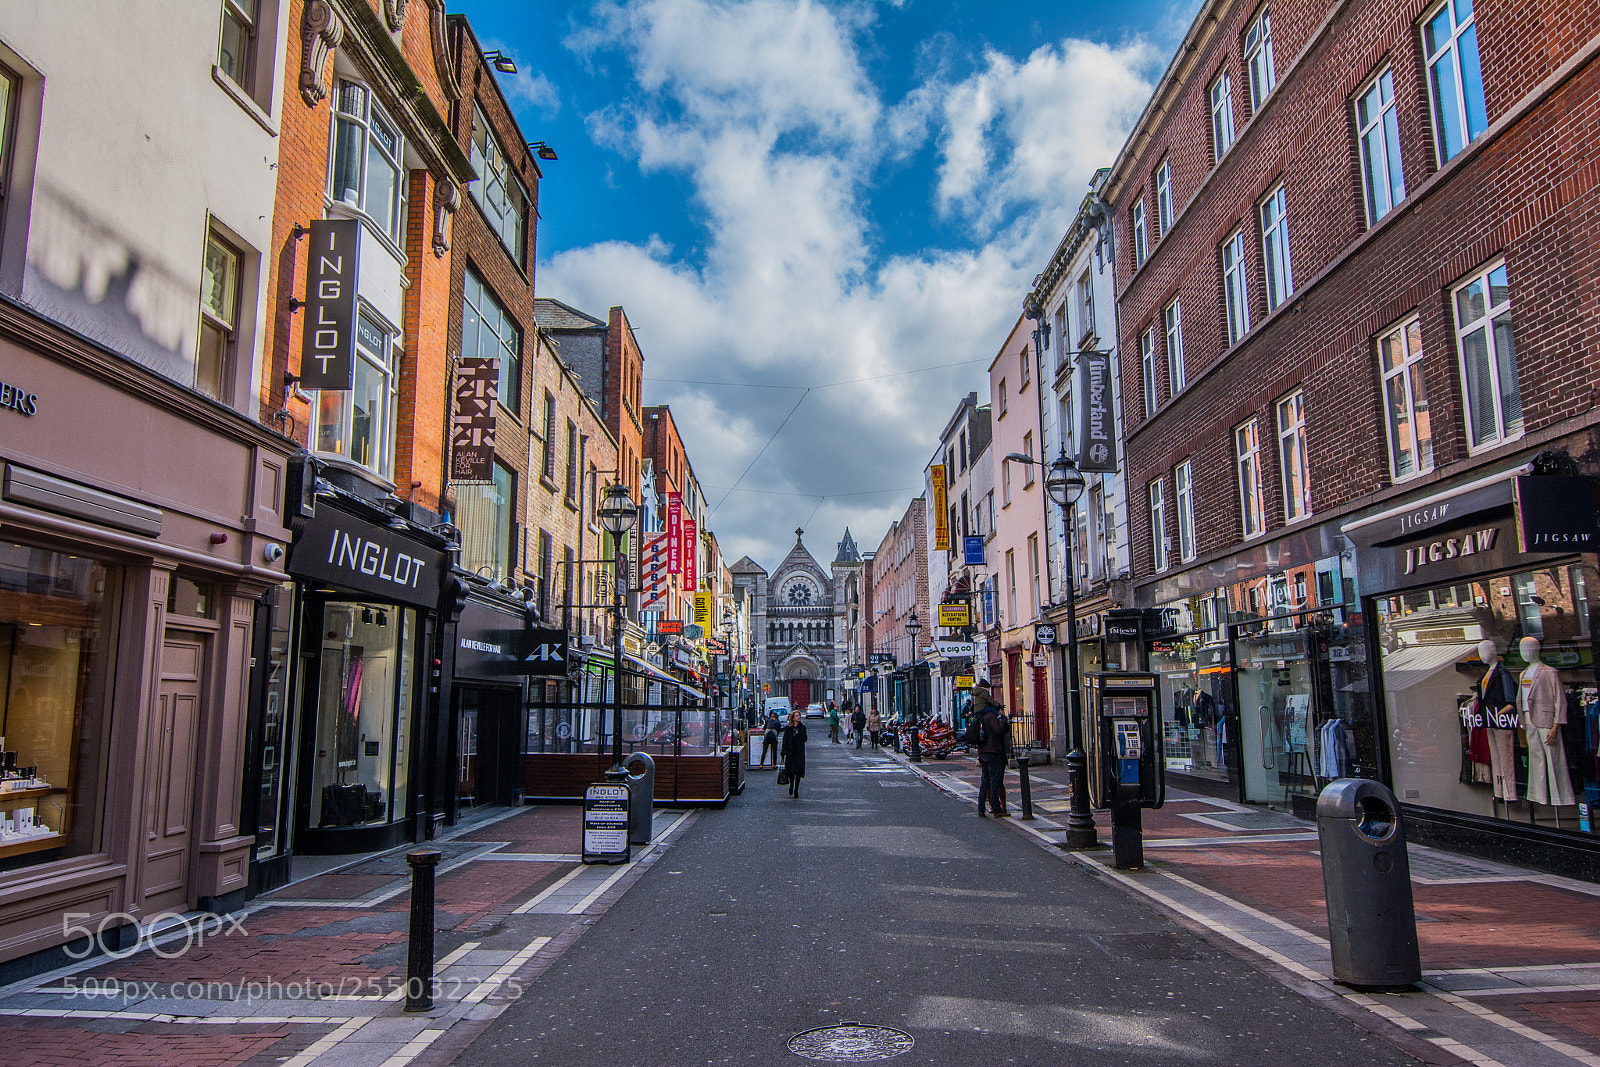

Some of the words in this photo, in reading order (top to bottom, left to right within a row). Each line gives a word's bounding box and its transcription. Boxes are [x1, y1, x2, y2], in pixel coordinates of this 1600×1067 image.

[314, 232, 342, 374] INGLOT
[359, 324, 382, 349] NGLOT
[1089, 356, 1108, 440] Timberland
[1401, 503, 1450, 534] JIGSAW
[1404, 528, 1496, 575] JIGSAW
[1534, 533, 1591, 545] JIGSAW
[328, 529, 426, 588] INGLOT
[650, 544, 659, 600] BARBER
[696, 597, 709, 622] GOTHAM
[460, 638, 471, 648] ALAN
[525, 644, 564, 661] AK
[1459, 705, 1483, 728] The
